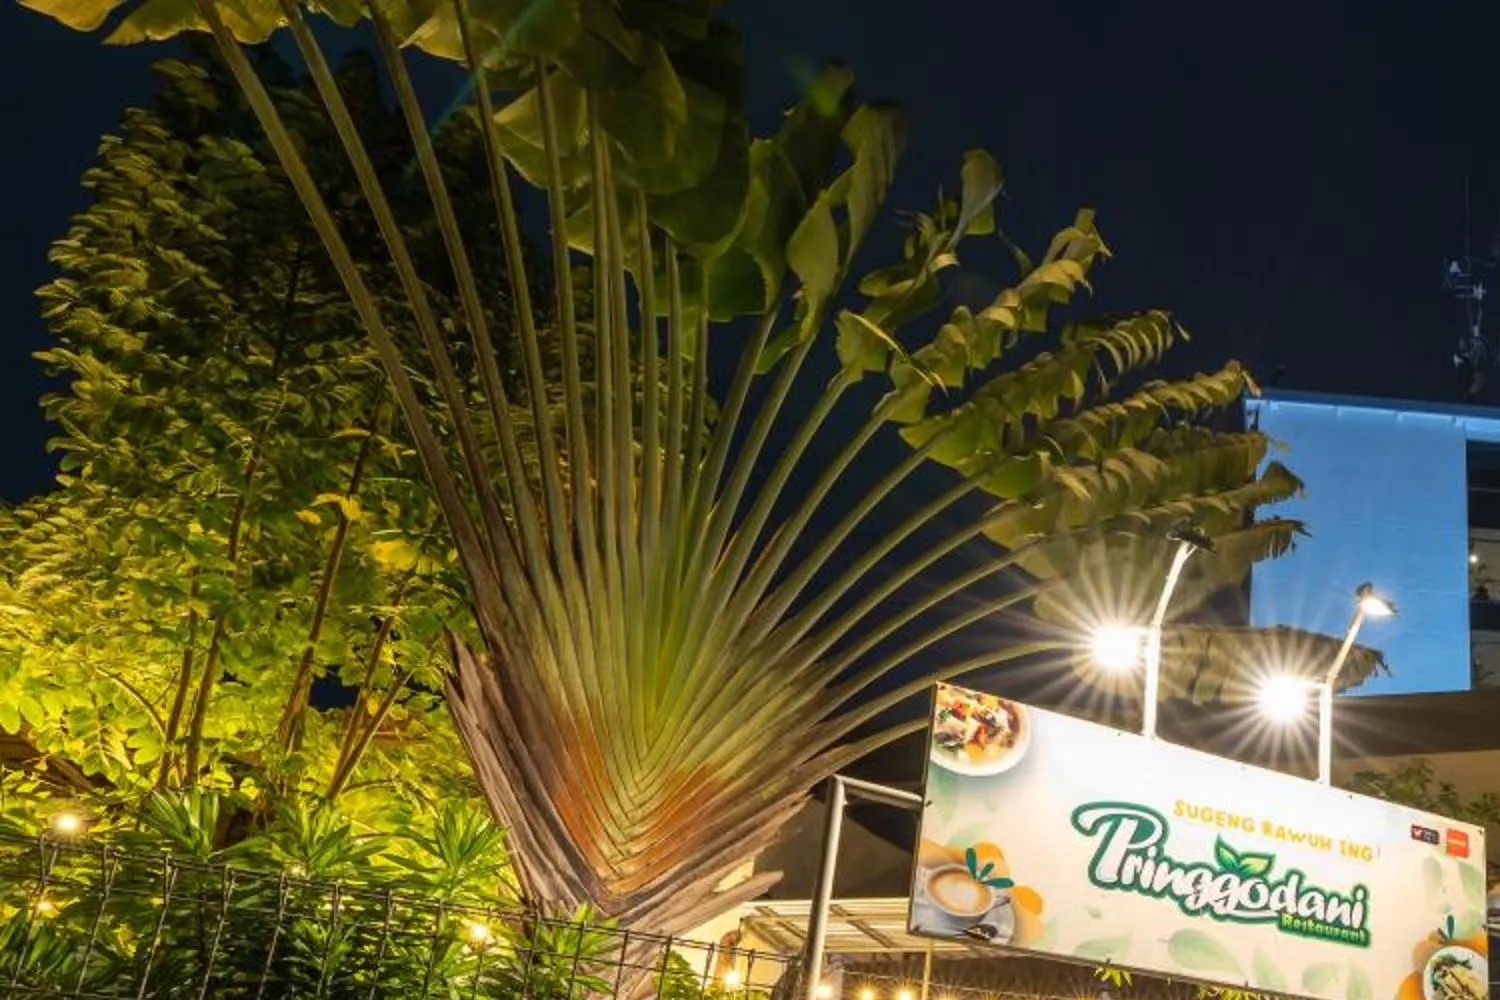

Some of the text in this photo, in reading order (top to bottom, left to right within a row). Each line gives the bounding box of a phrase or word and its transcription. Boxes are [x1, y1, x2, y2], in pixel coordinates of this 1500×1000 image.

[1174, 799, 1375, 863] SUGENG RAWUH ING
[1072, 803, 1369, 931] Pringgodani
[1280, 912, 1368, 944] Restaurant
